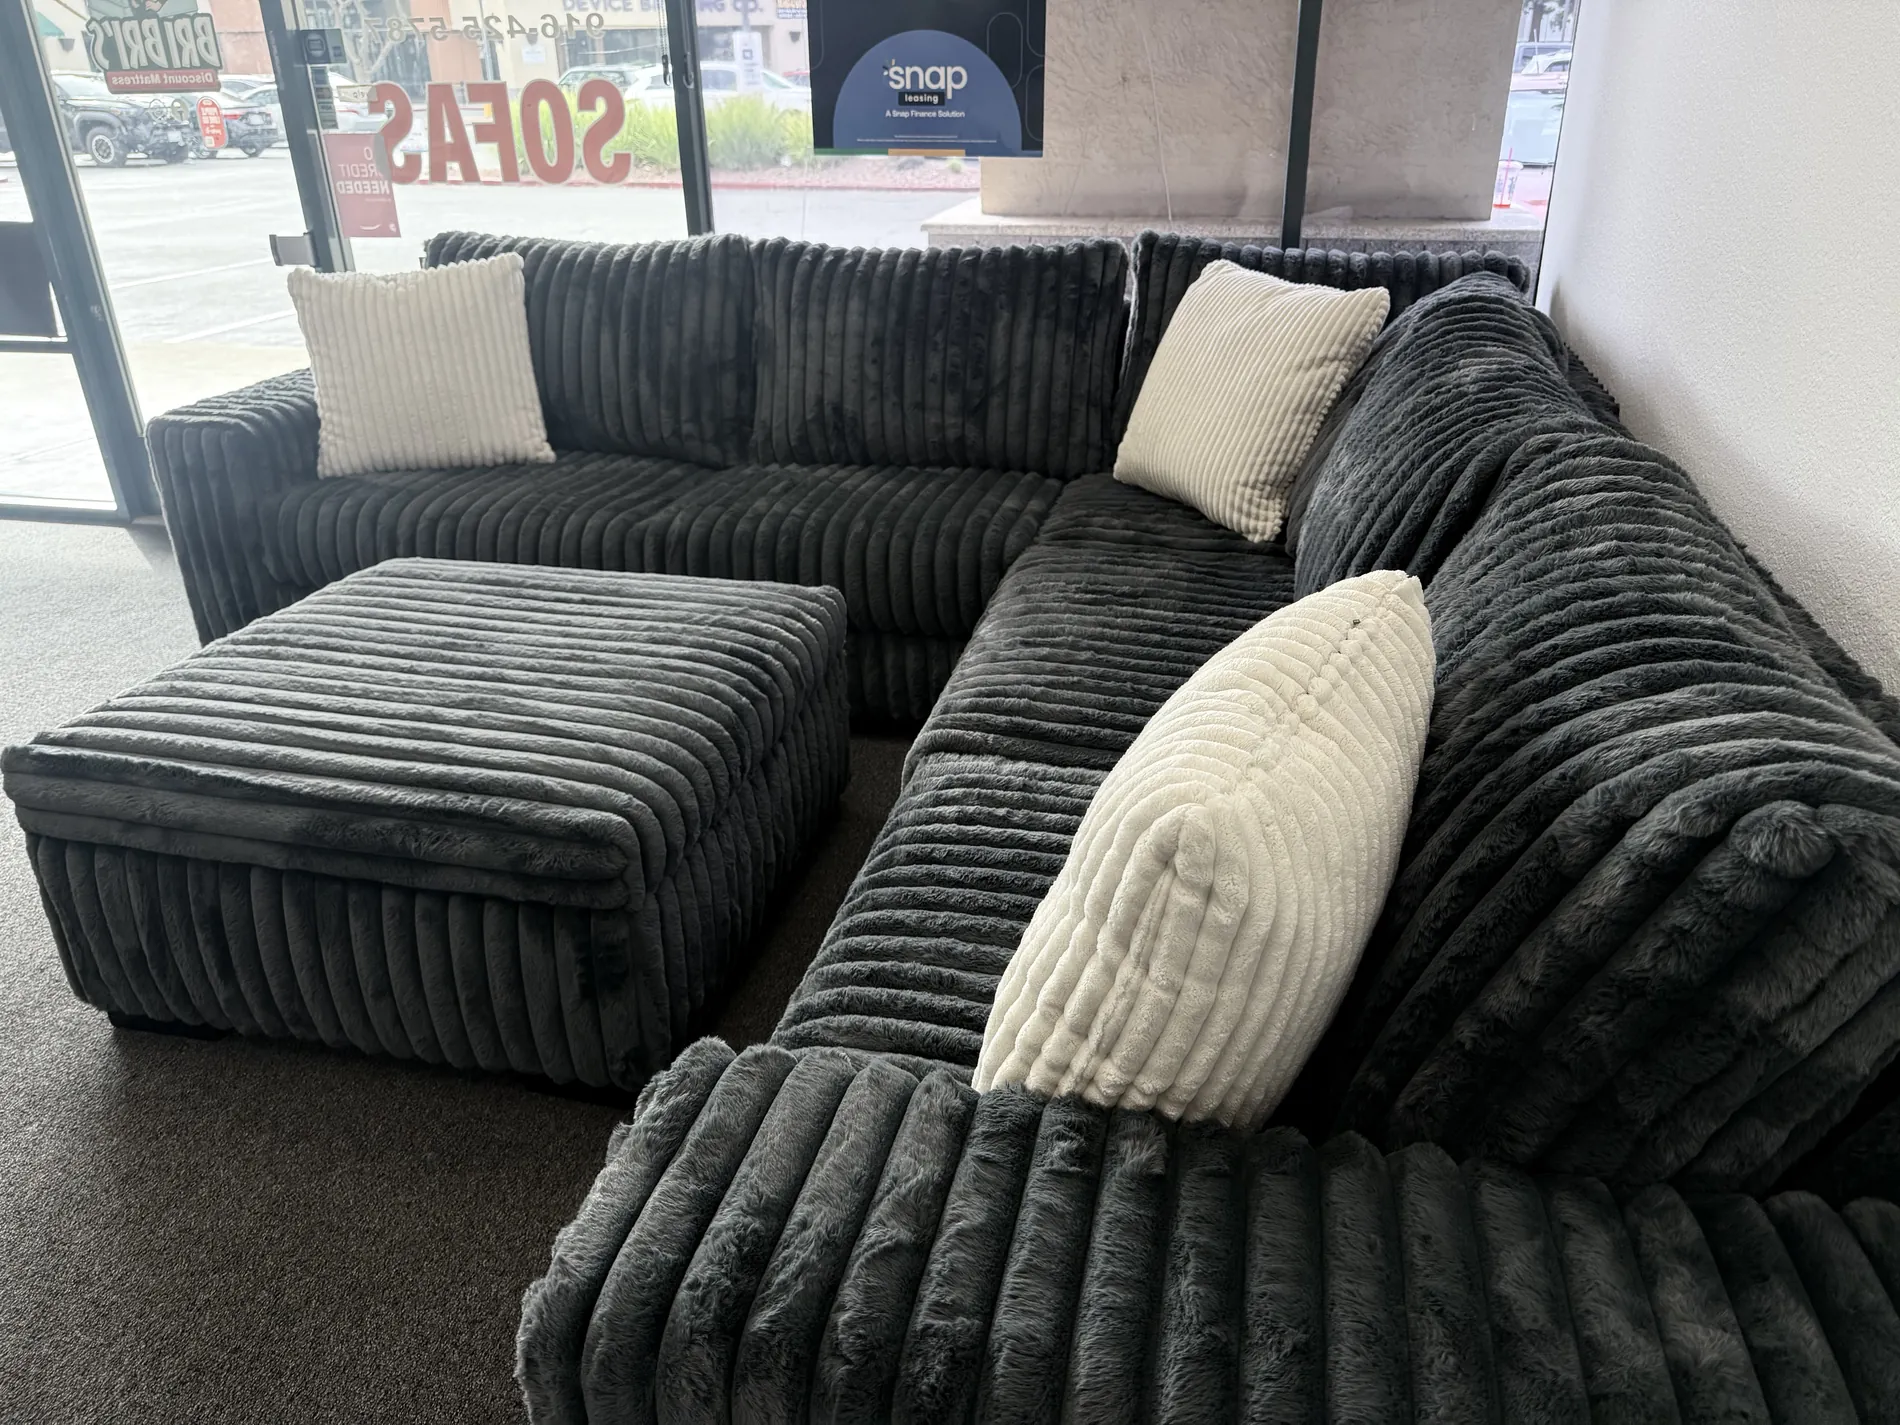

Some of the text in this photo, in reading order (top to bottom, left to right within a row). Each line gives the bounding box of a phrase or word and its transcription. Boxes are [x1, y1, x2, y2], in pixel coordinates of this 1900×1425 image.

[888, 65, 968, 99] snap
[904, 93, 939, 104] leasing
[885, 110, 965, 119] A Snap Finance Solution
